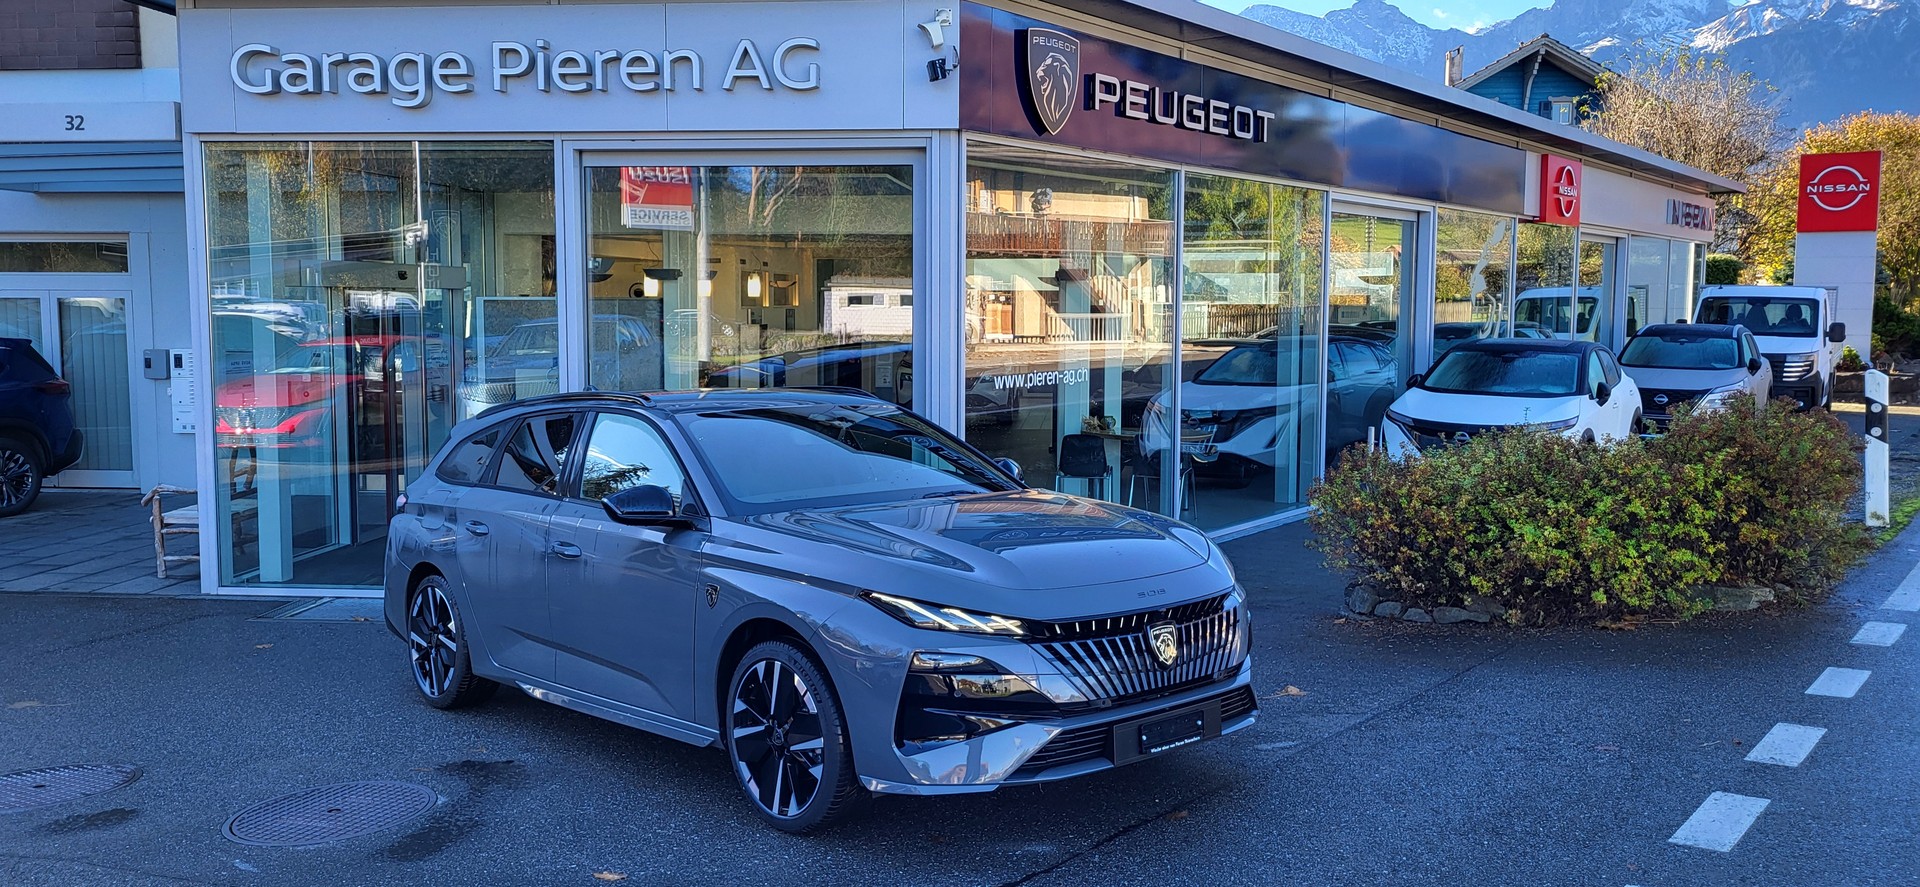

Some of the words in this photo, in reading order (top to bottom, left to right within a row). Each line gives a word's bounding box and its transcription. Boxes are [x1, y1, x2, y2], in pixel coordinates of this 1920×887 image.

[1033, 36, 1077, 53] PEUGEOT
[230, 43, 474, 109] Garage
[492, 39, 704, 92] Pieren
[722, 37, 820, 91] AG
[1094, 72, 1276, 143] PEUGEOT
[64, 115, 85, 131] 32
[1559, 185, 1578, 197] NISSAN
[1806, 184, 1871, 193] NISSAN
[994, 367, 1088, 389] www.pieren-ag.ch
